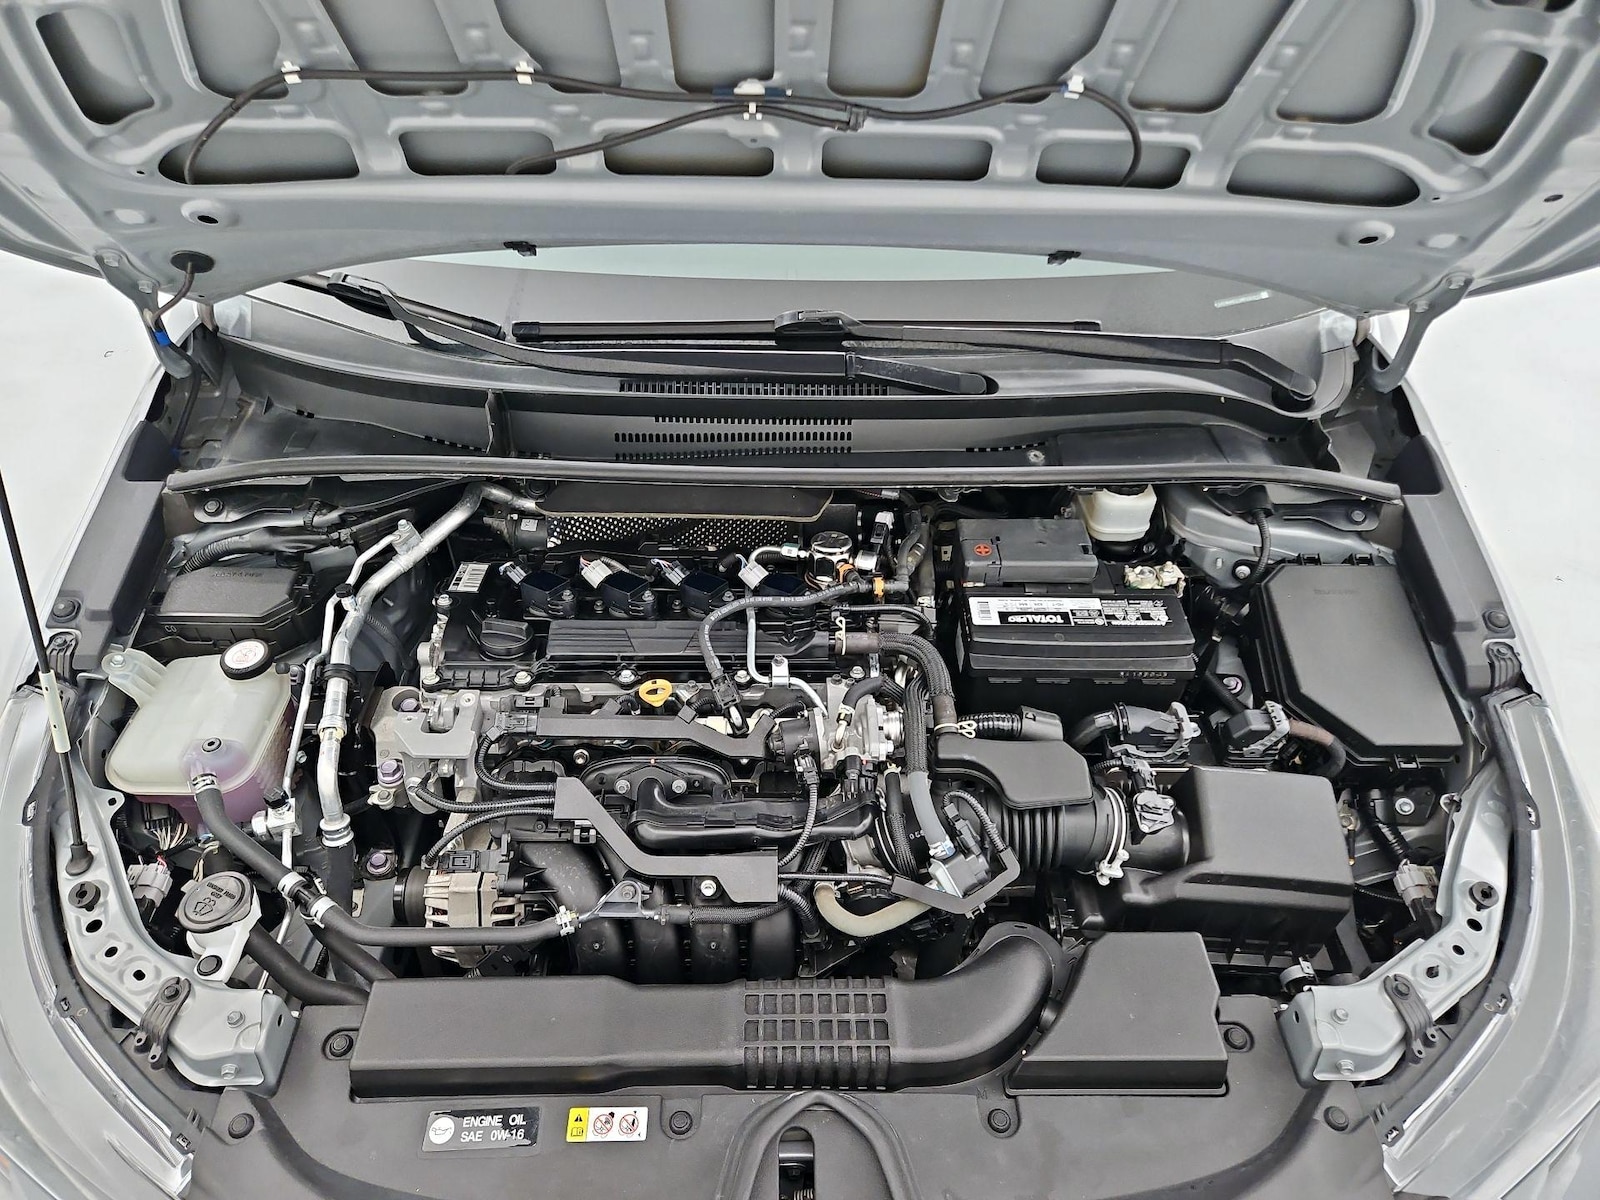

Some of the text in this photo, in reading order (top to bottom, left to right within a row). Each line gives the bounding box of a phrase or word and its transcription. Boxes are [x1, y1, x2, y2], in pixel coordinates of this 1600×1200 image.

[462, 1113, 527, 1128] ENGINE OIL
[460, 1128, 525, 1143] SAE 0W-16
